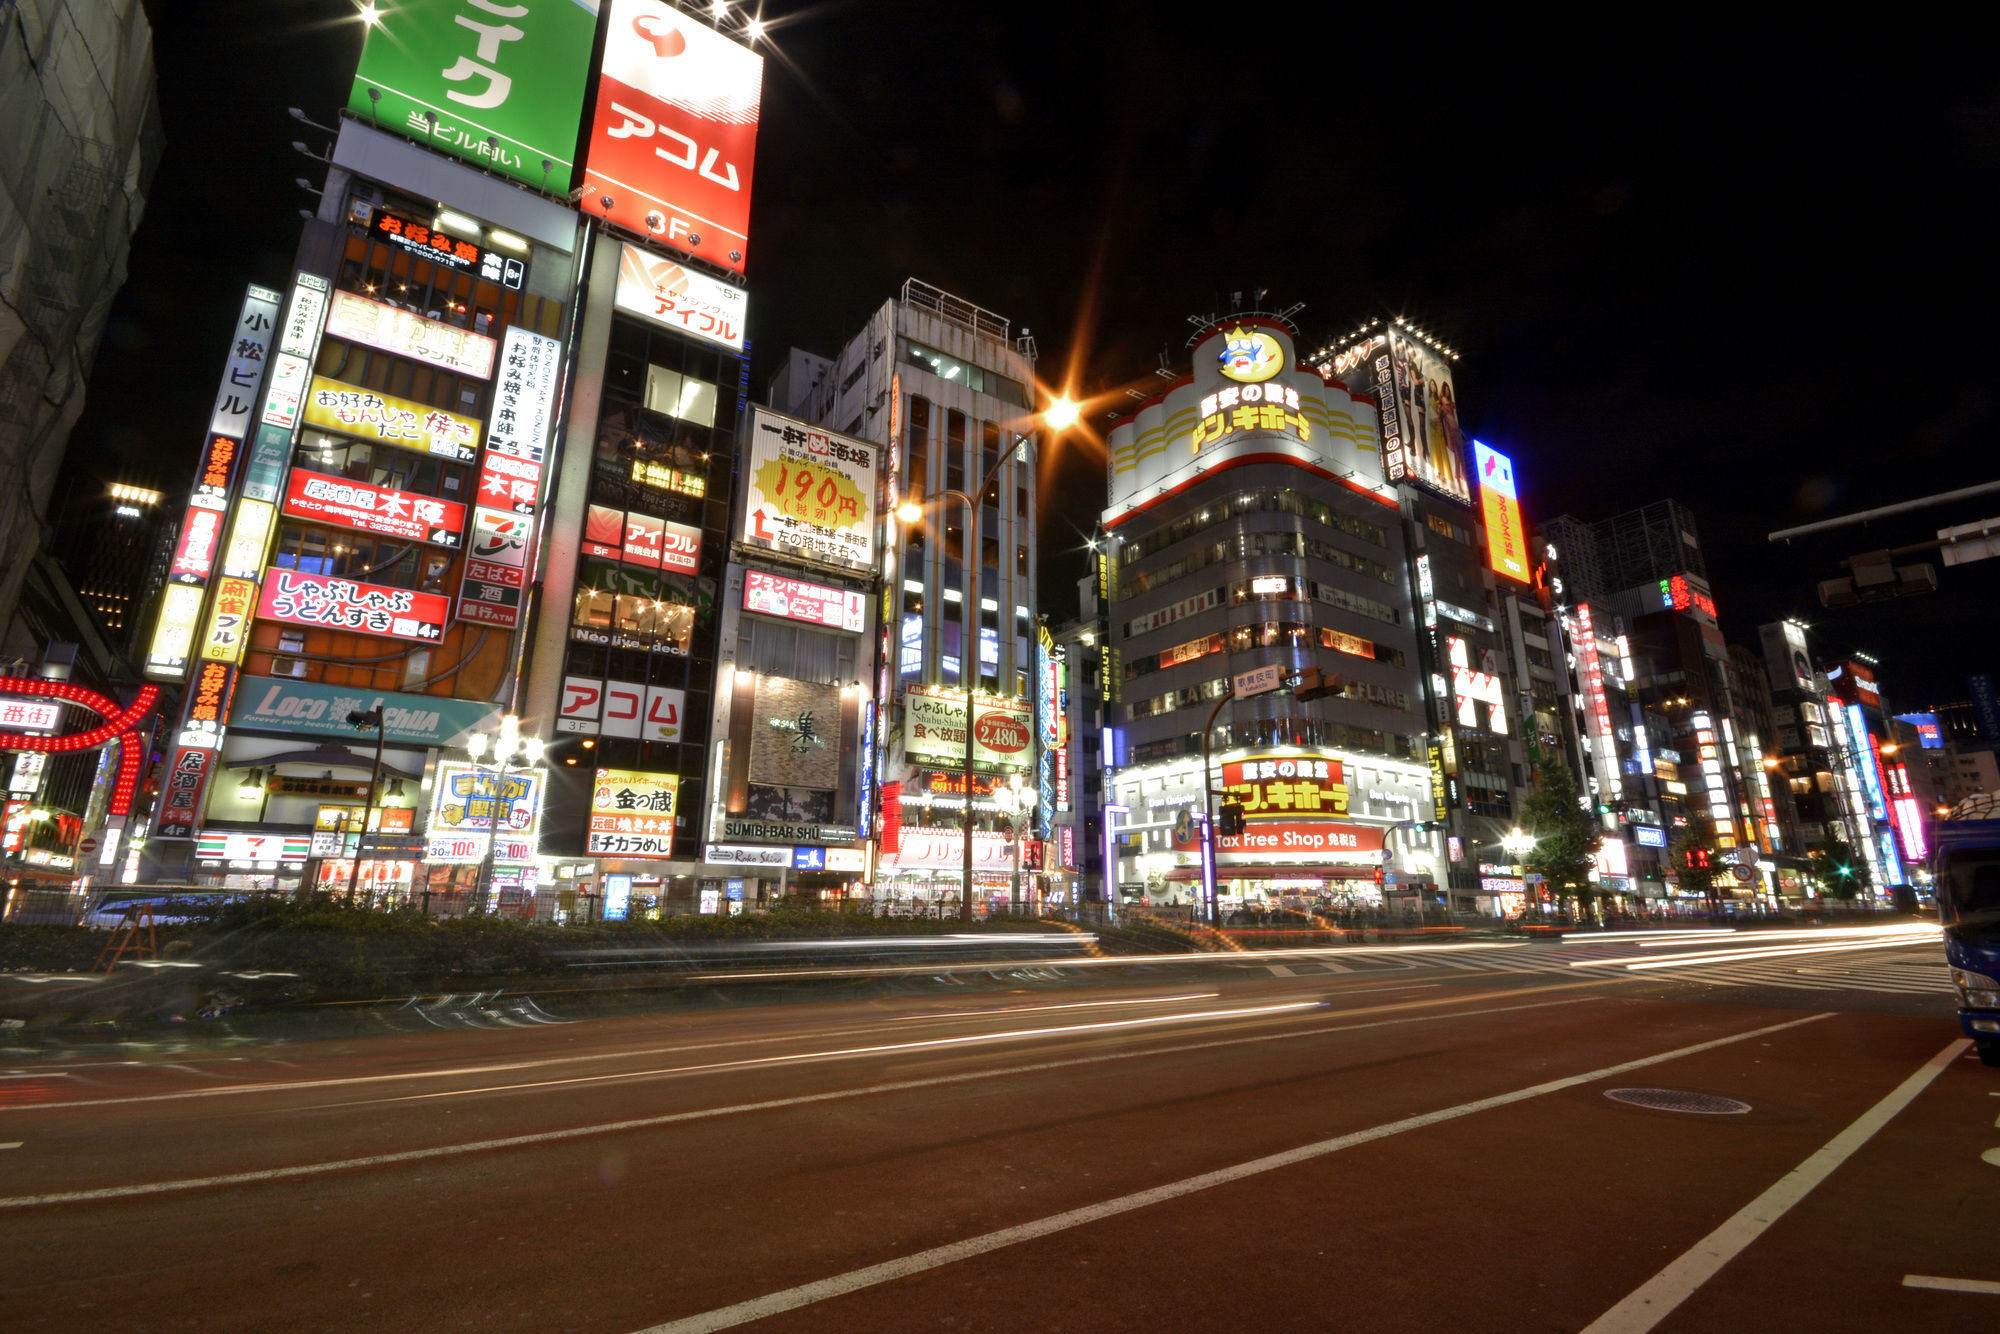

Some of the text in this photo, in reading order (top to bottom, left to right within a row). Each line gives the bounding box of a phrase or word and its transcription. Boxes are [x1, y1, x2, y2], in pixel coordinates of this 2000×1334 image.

[406, 110, 521, 169] 当ビル向い
[607, 102, 740, 191] アコム
[379, 215, 478, 263] お好み焼
[507, 268, 520, 280] 8F
[724, 288, 741, 301] 5F
[655, 295, 737, 341] アイフル
[219, 313, 270, 415] 小松ビル
[318, 391, 384, 408] お好み
[337, 408, 416, 427] もんじゃ
[426, 412, 474, 442] 焼き
[379, 423, 420, 439] たこ
[204, 438, 234, 487] お好み焼
[458, 446, 475, 460] 7F
[303, 478, 376, 510] 居酒屋
[481, 473, 537, 502] 本陣
[776, 463, 858, 517] 190円
[376, 492, 447, 527] 本陣
[515, 503, 533, 514] 4F
[1497, 494, 1514, 557] PROMISE
[432, 530, 456, 546] 4F
[627, 523, 697, 554] アイフル
[777, 529, 860, 559] 左の路地を右へ
[593, 546, 608, 556] 5F
[625, 543, 660, 560] 新規会員
[469, 562, 520, 585] たばこ
[279, 572, 414, 613] しゃぶしゃぶ
[480, 584, 505, 602] 酒
[273, 599, 393, 631] うどんすき
[419, 622, 441, 638] 4F
[211, 646, 230, 657] 6F
[576, 629, 689, 656] Neo live deco
[193, 662, 227, 721] お好み焼
[2, 705, 52, 725] 番街
[562, 684, 678, 725] アコム
[569, 720, 587, 731] 3F
[912, 722, 966, 743] 食べ放題
[981, 725, 1018, 747] 2,480
[170, 751, 204, 809] 居酒屋
[454, 775, 529, 799] まんが
[615, 787, 672, 812] 金の蔵
[163, 825, 188, 837] 4F
[471, 818, 506, 827] マンー
[592, 817, 616, 829] 元祖
[617, 818, 671, 834] 焼き牛丼
[725, 822, 793, 838] SUMIBI-BAR
[600, 835, 670, 852] チカラめし
[1216, 832, 1357, 848] Tax Free Shop 免税店
